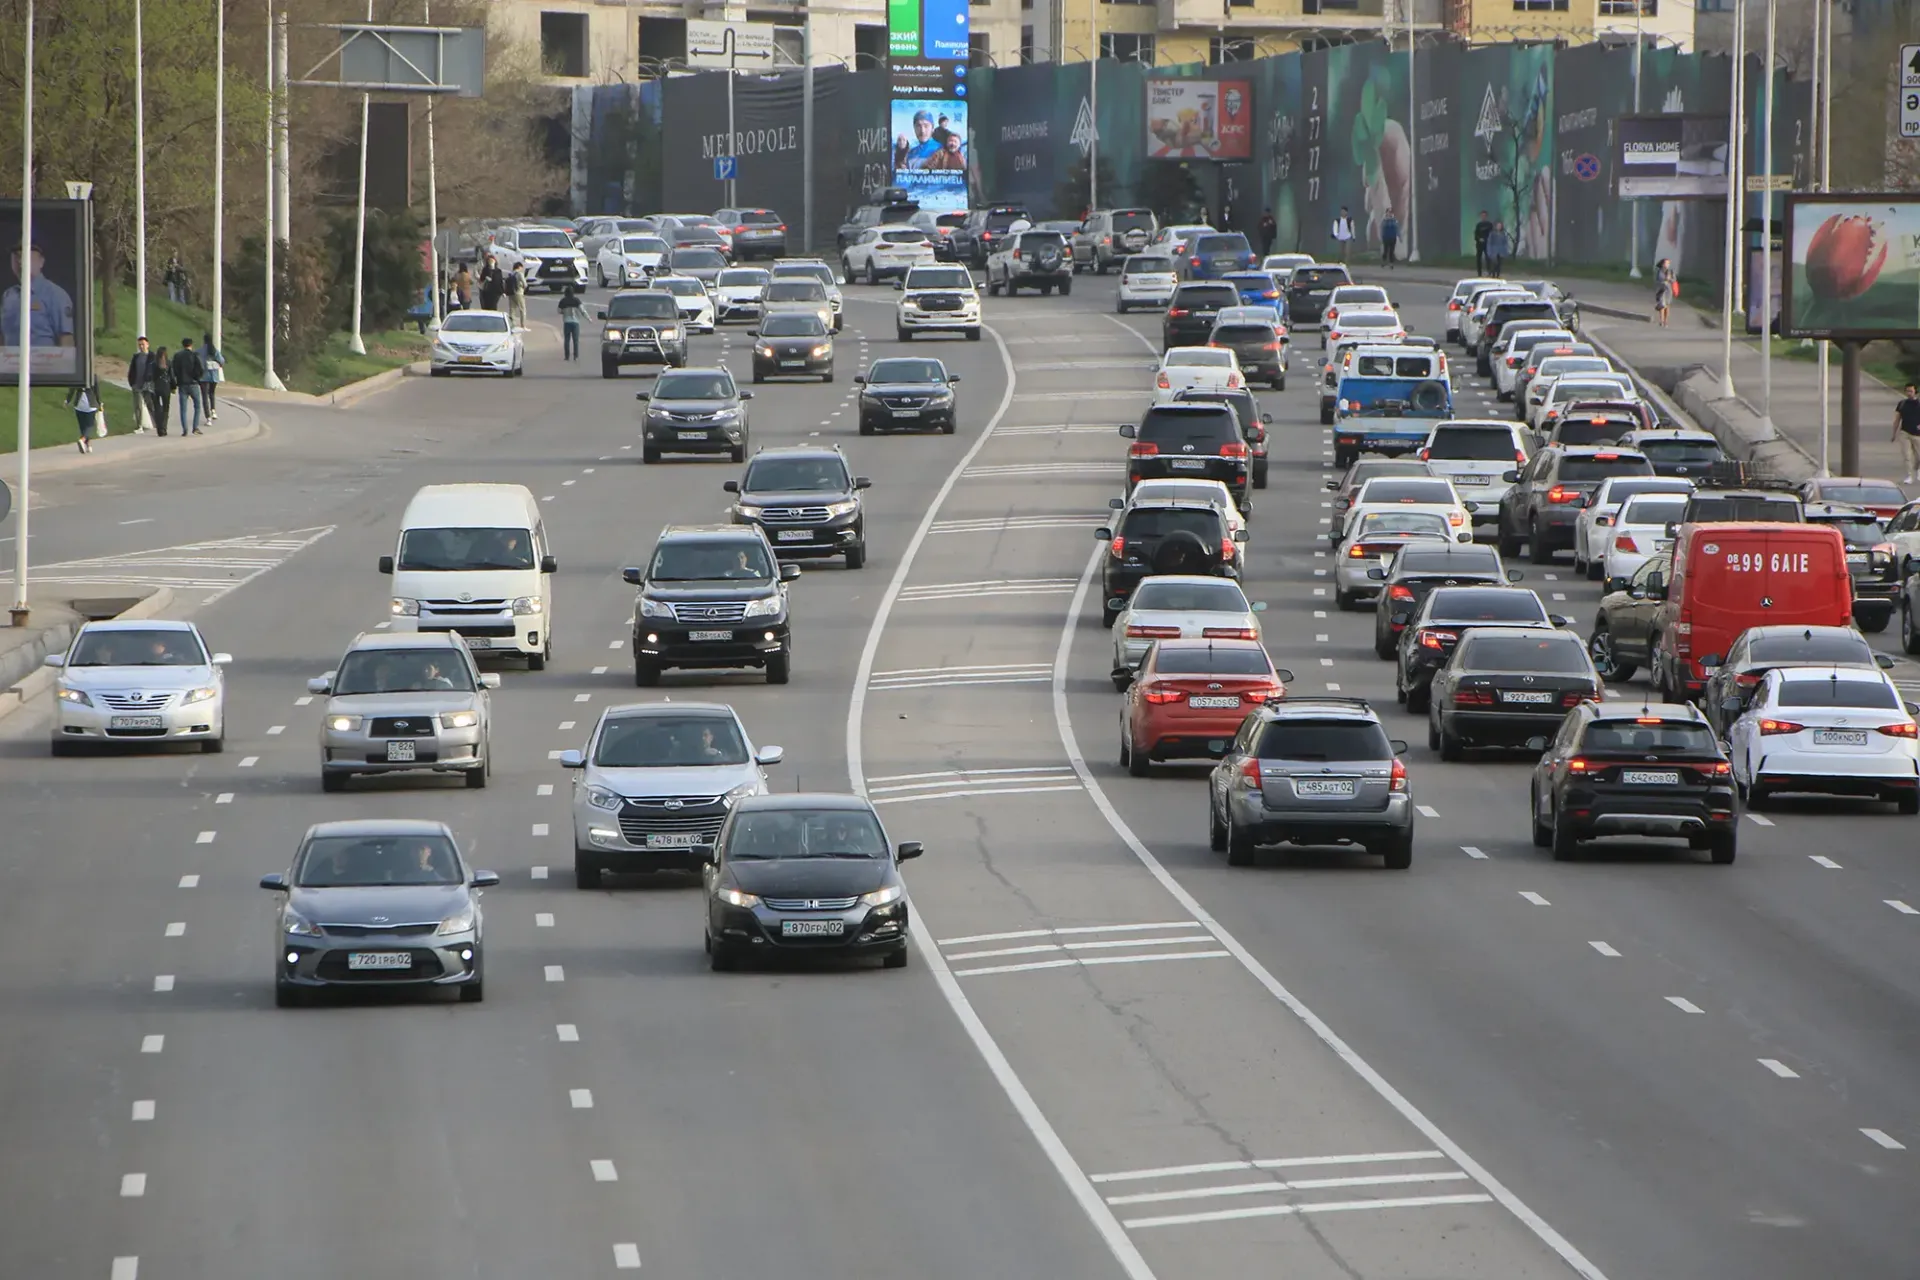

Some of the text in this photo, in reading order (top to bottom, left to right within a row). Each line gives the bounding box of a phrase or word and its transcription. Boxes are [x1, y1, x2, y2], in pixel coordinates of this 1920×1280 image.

[702, 125, 798, 159] METROPOLE
[1624, 141, 1680, 152] FLORYA HOME
[1014, 154, 1037, 172] ОКНА
[1727, 553, 1739, 564] 08
[1665, 774, 1678, 783] 02
[1340, 780, 1353, 790] 02
[690, 834, 702, 844] 02
[829, 923, 842, 933] 02
[358, 954, 376, 965] 720
[397, 954, 411, 965] 02
